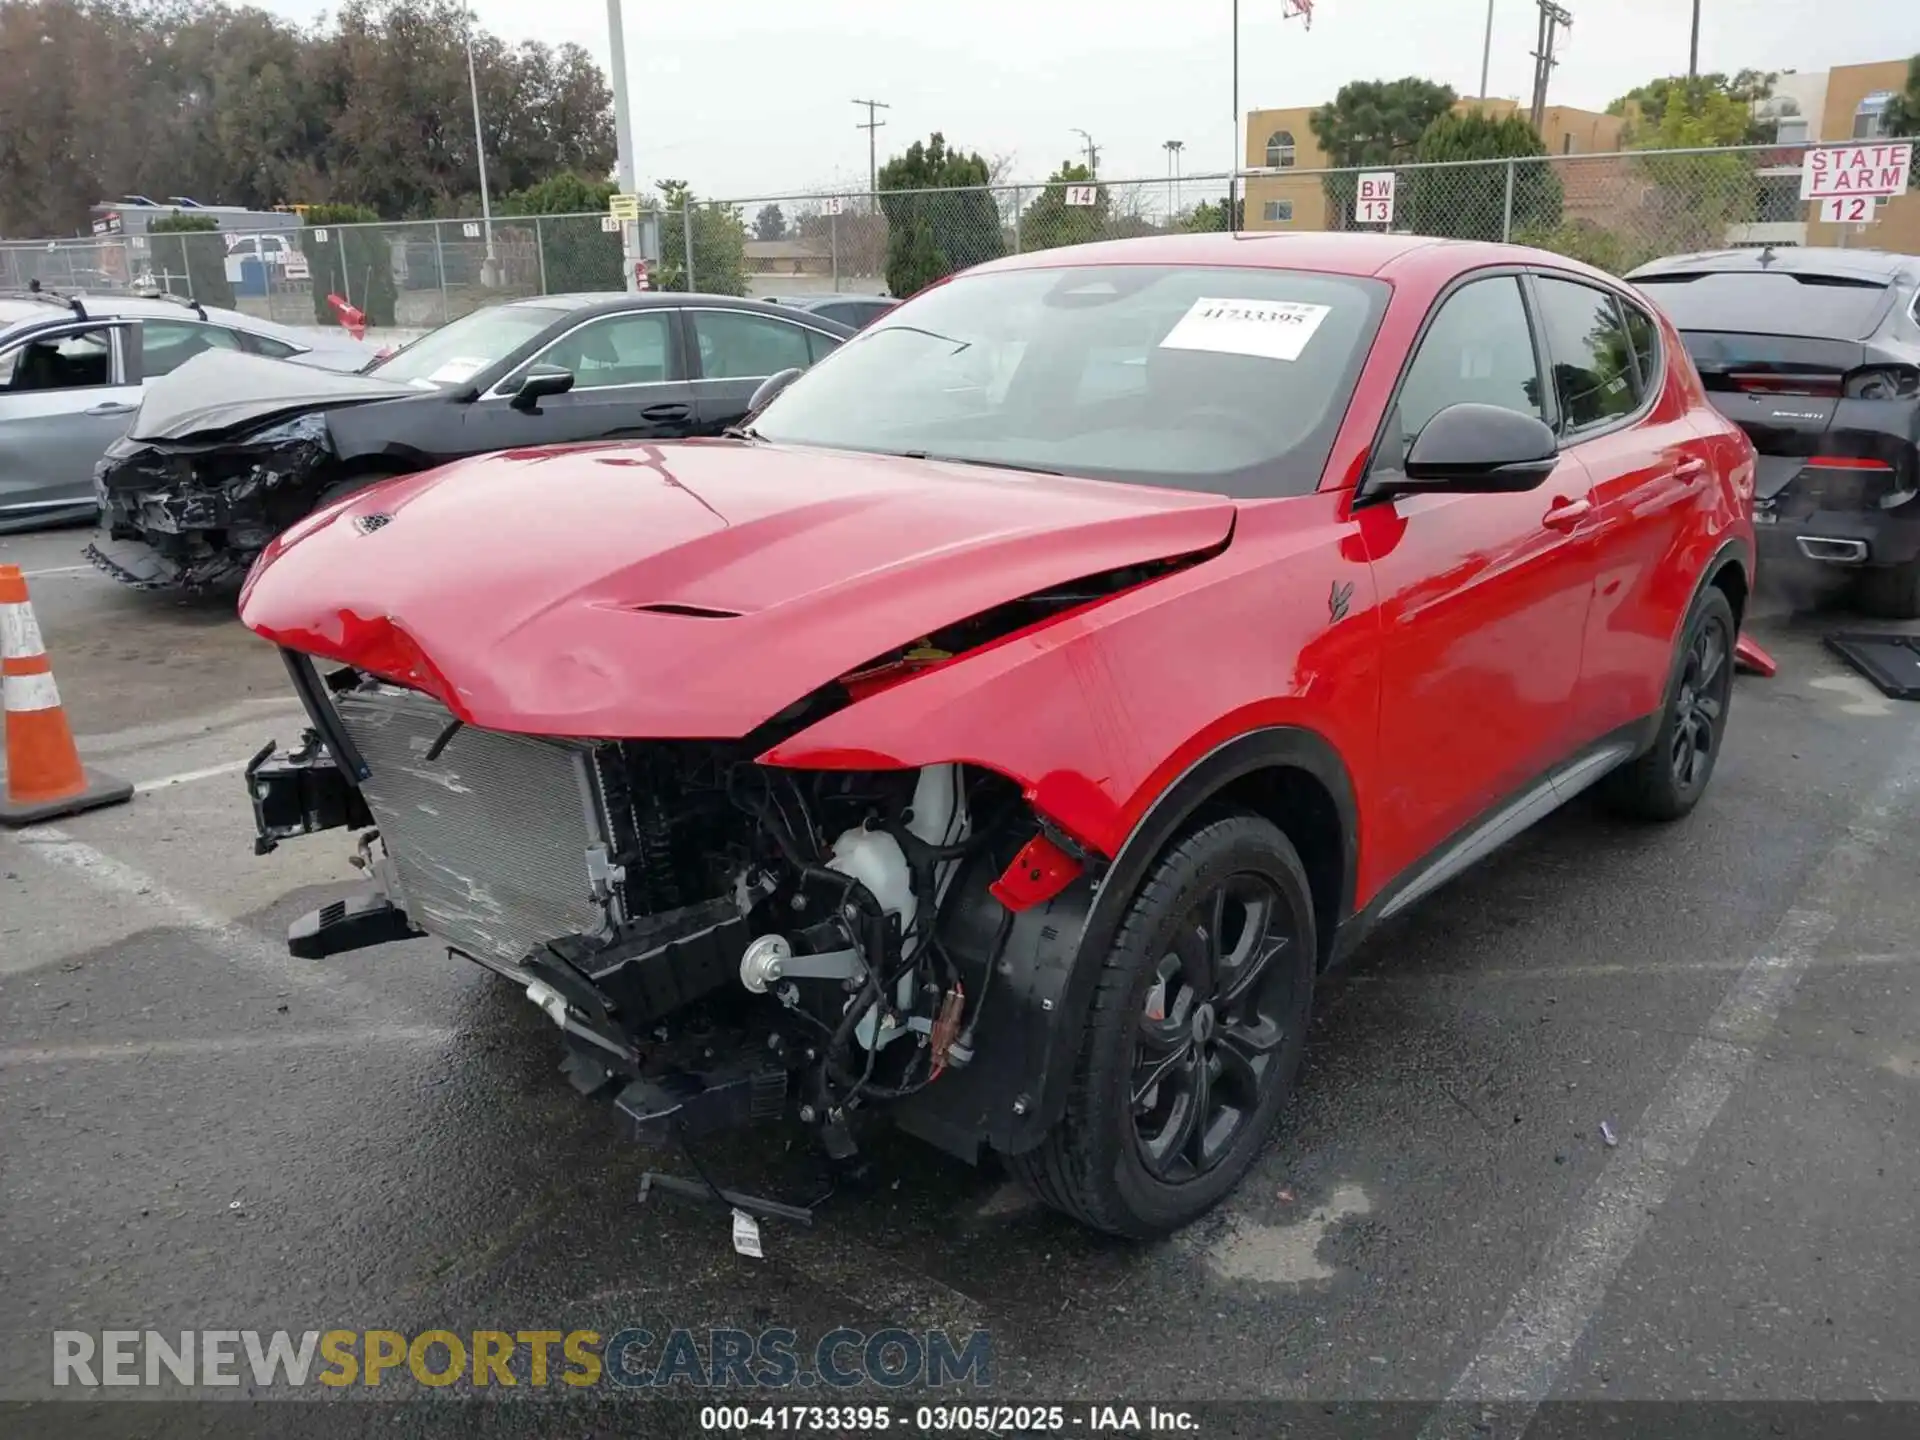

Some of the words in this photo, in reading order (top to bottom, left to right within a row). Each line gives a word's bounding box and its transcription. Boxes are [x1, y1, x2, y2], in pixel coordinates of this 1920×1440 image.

[1811, 146, 1908, 171] STATE
[1813, 167, 1901, 191] FARM
[1072, 187, 1091, 204] 14
[825, 199, 840, 214] 15
[1364, 202, 1388, 221] 13
[1831, 199, 1866, 221] 12
[1200, 307, 1307, 325] 41733395
